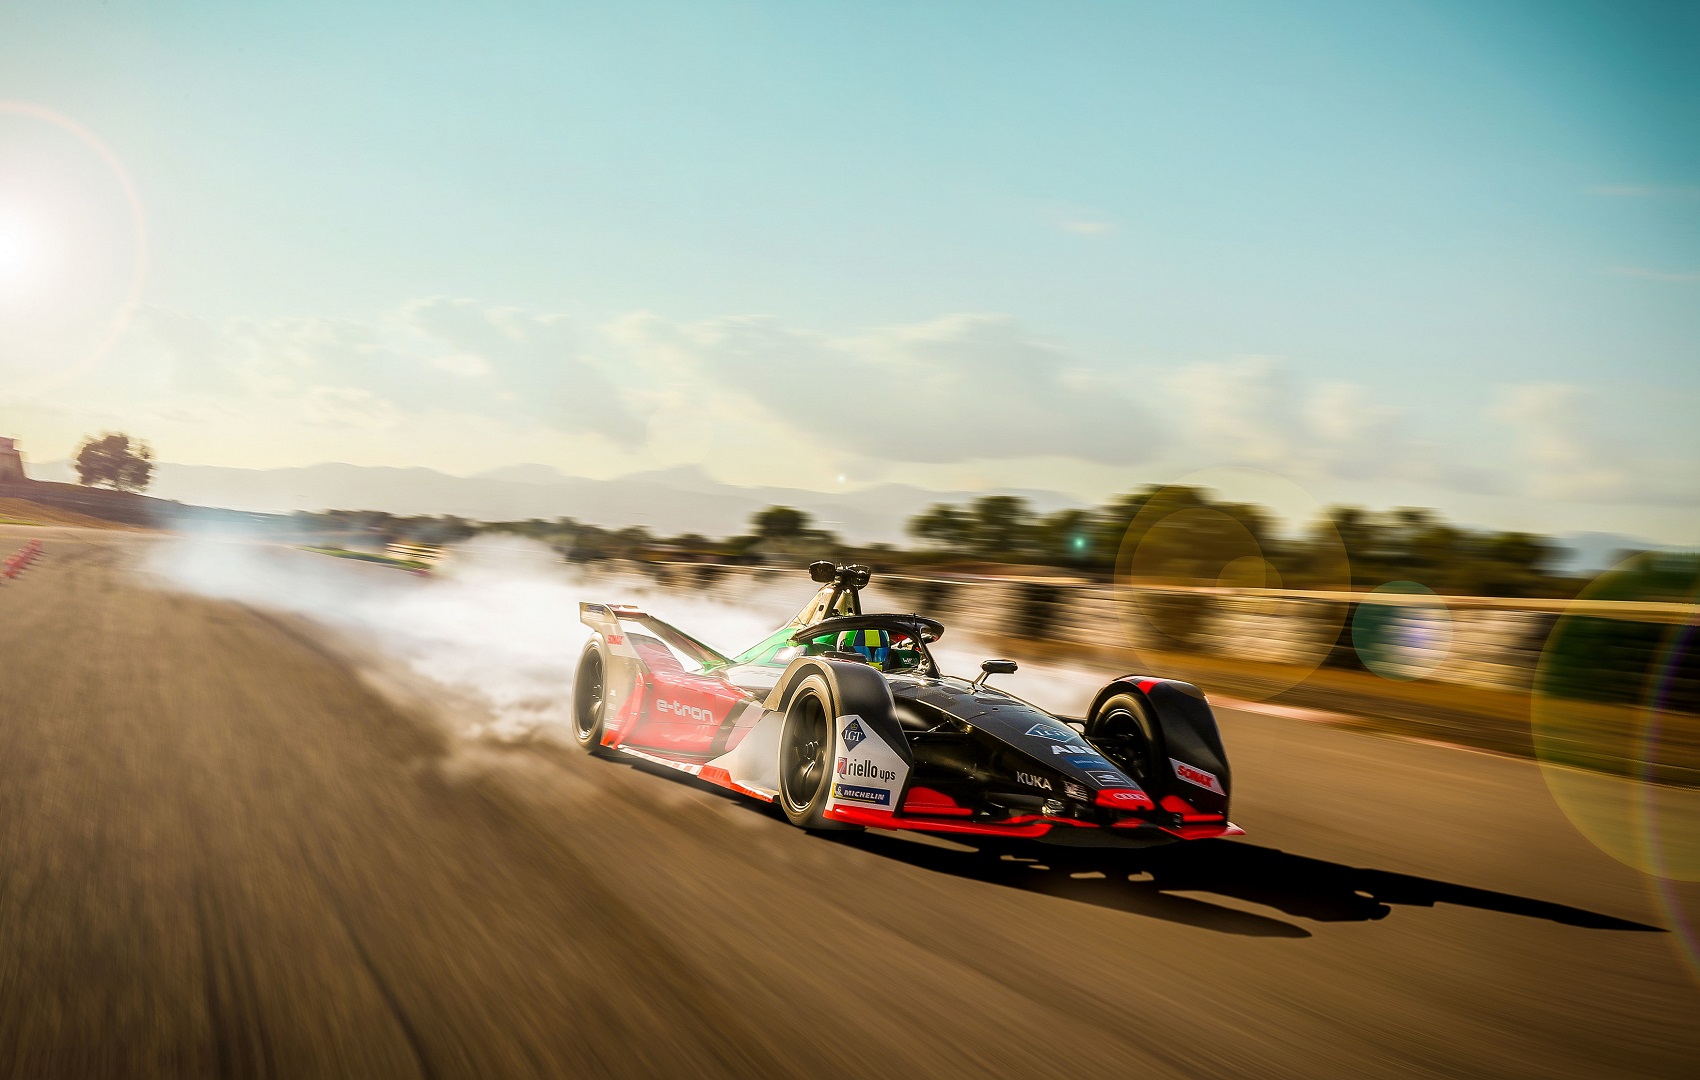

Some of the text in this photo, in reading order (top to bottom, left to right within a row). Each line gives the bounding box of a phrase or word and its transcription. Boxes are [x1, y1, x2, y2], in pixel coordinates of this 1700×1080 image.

[656, 698, 716, 725] e-tron
[844, 730, 862, 741] LGT
[848, 759, 896, 783] riello ups
[1016, 771, 1053, 791] KUKA
[844, 789, 885, 800] MICHELIN
